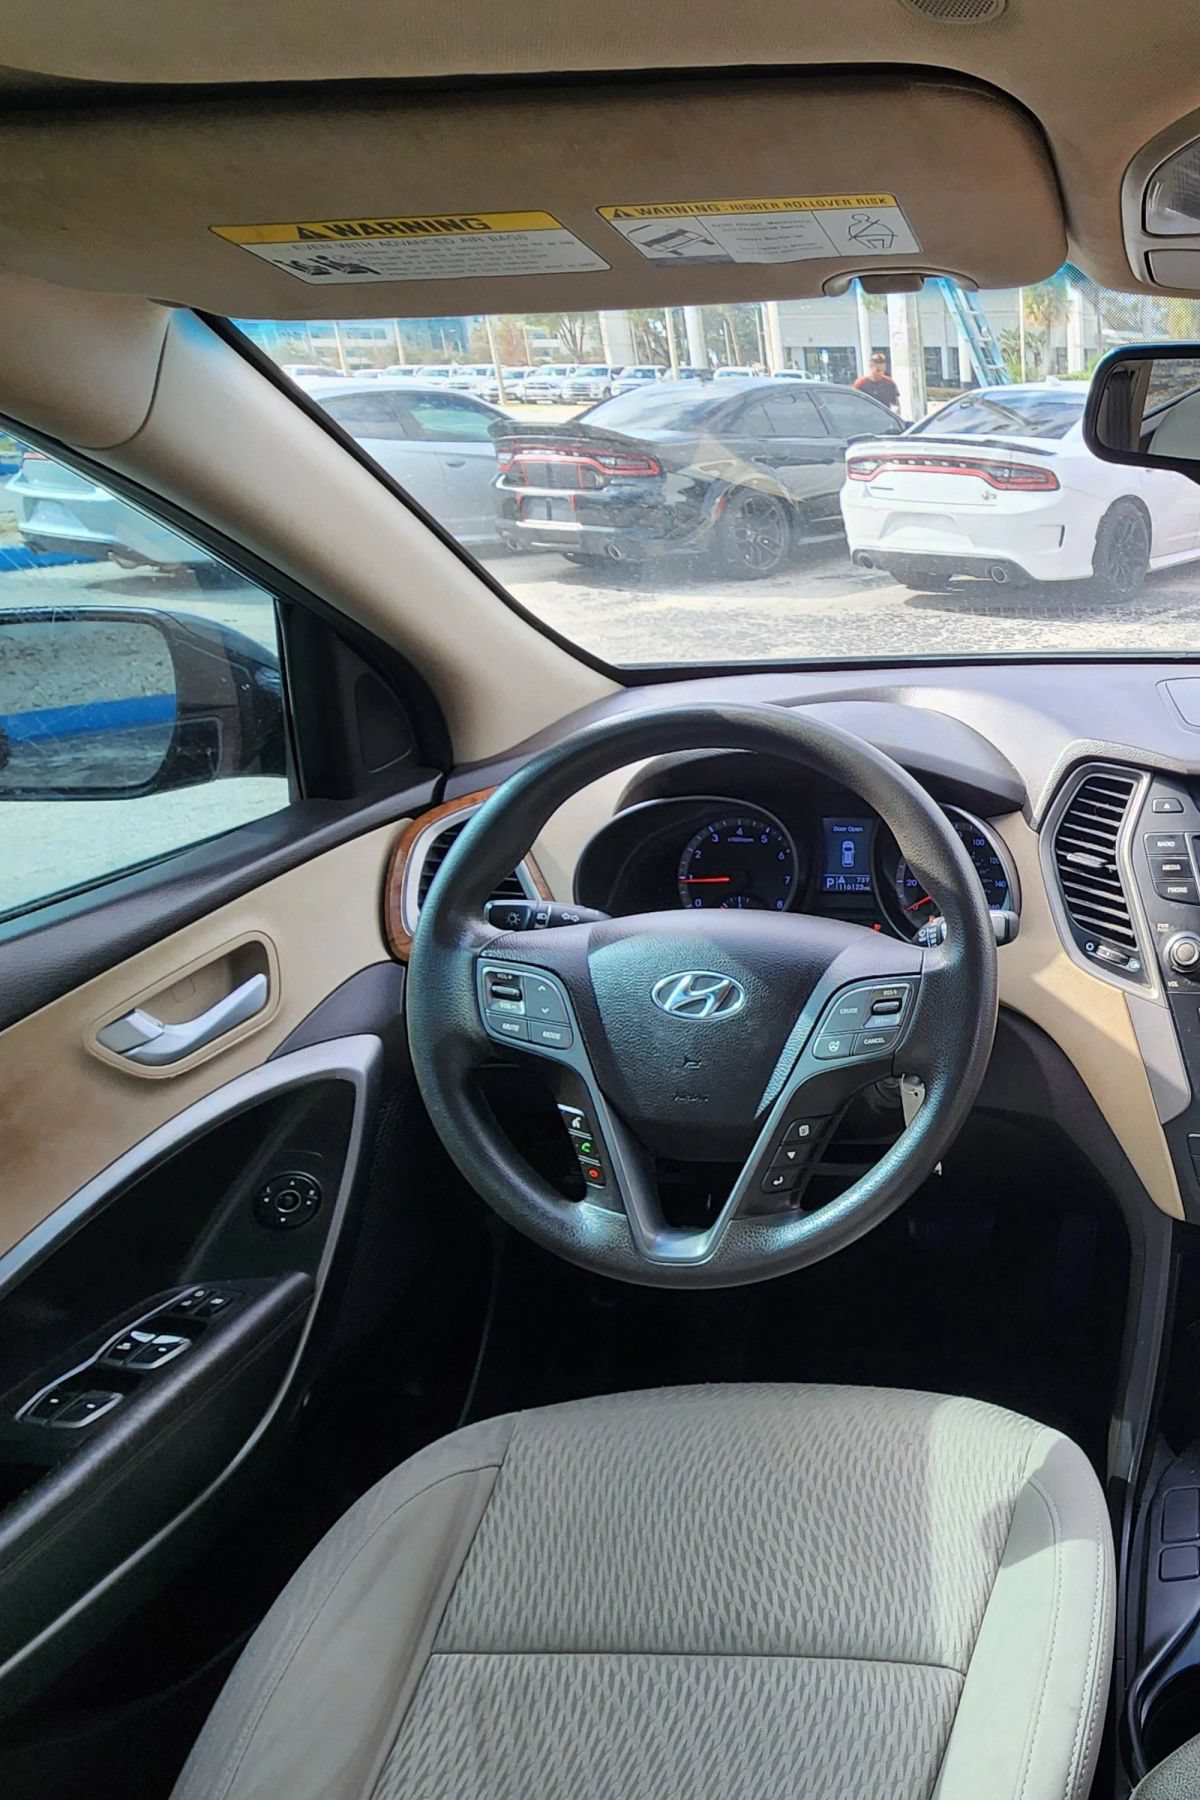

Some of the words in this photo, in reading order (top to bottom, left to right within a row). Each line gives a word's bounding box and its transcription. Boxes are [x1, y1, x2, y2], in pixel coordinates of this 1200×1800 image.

[783, 197, 852, 209] ROLLOVER
[854, 196, 888, 206] RISK
[322, 217, 492, 238] WARNING
[736, 827, 744, 835] 4
[711, 833, 719, 843] 3
[760, 834, 768, 844] 5
[973, 838, 985, 846] 100
[694, 850, 702, 859] 2
[778, 851, 785, 860] 6
[784, 875, 791, 885] 7
[826, 877, 835, 889] P
[906, 879, 918, 887] 20
[694, 898, 702, 908] 0
[863, 1037, 886, 1045] CANCEL
